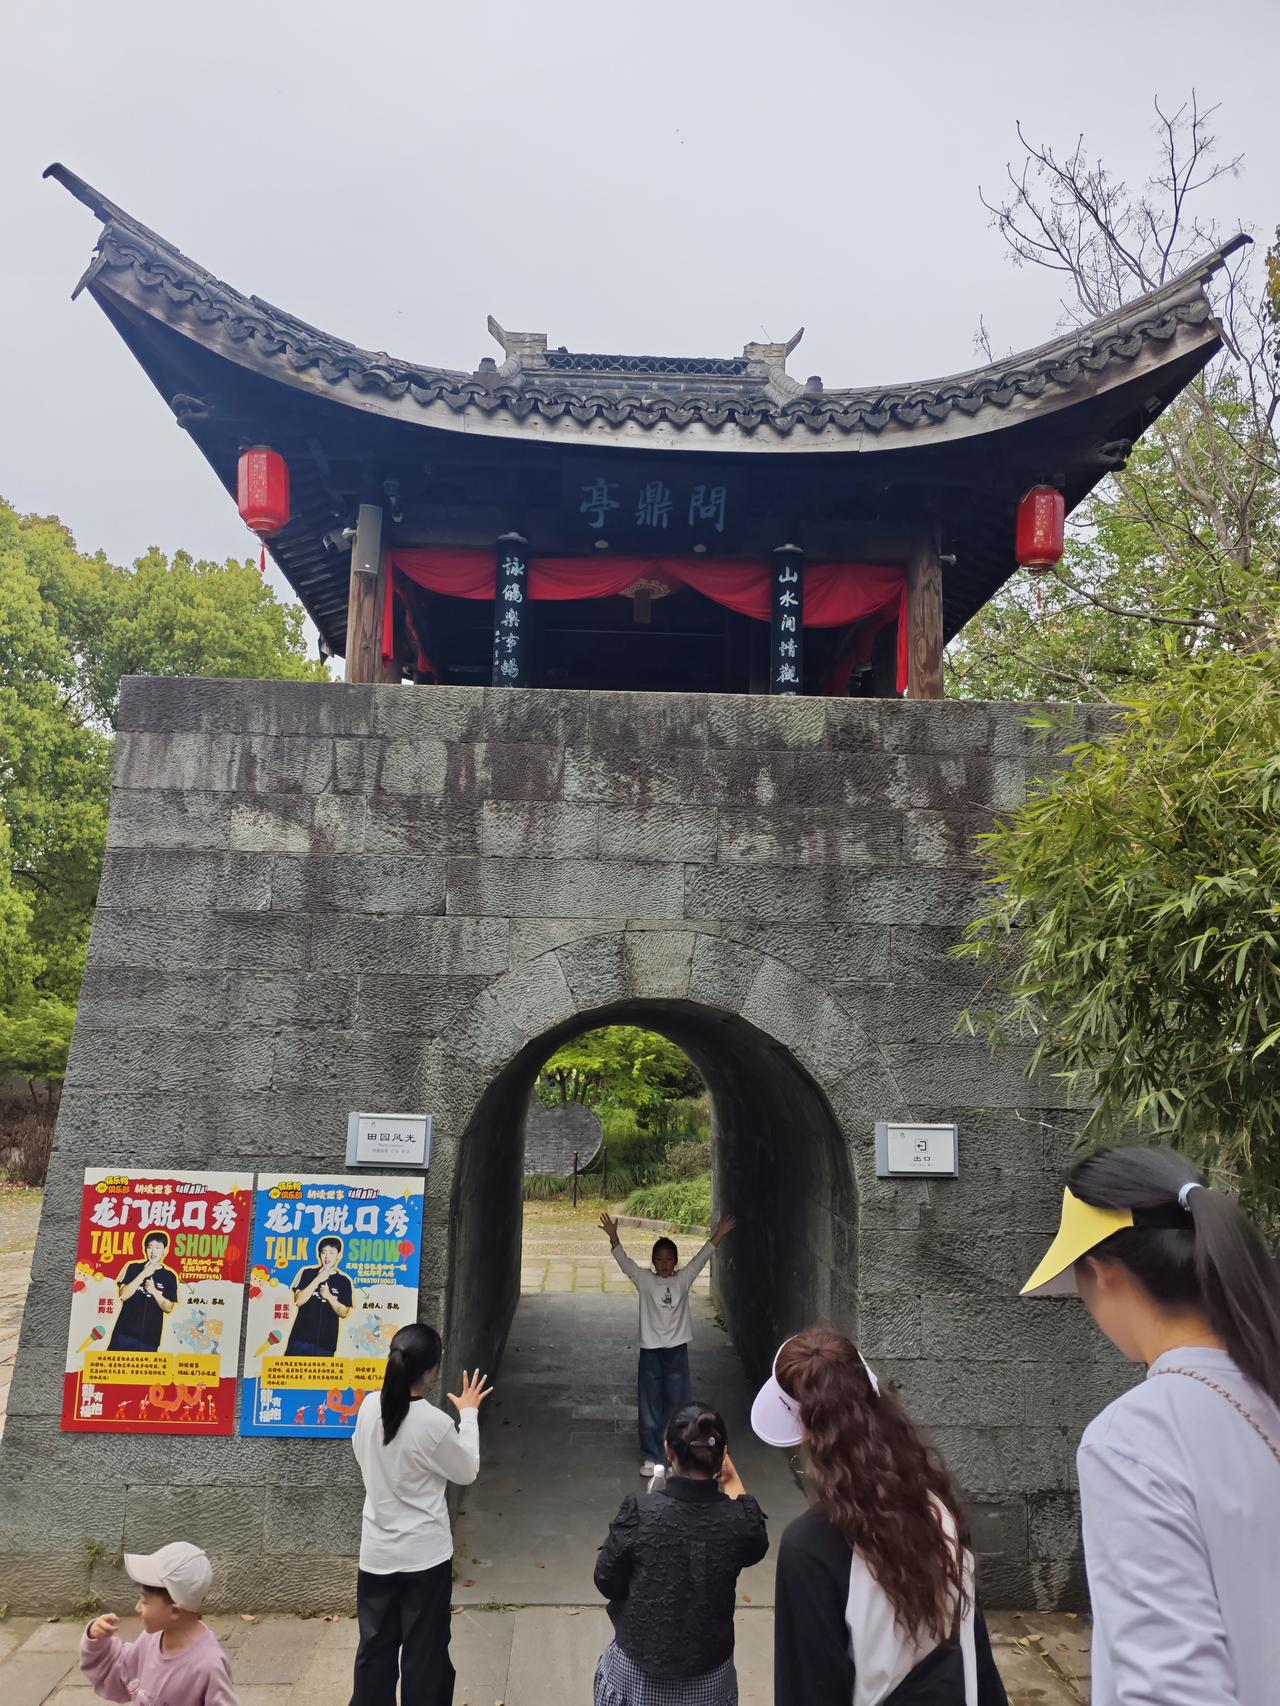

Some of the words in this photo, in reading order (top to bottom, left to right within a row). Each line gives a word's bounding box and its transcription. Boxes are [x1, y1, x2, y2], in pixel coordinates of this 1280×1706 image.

[367, 1132, 417, 1143] 田园风光
[89, 1196, 238, 1233] 龙门脱口秀
[264, 1201, 410, 1238] 龙门脱口秀
[90, 1231, 136, 1255] TALK
[174, 1233, 229, 1258] SHOW
[265, 1236, 310, 1261] TALK
[349, 1238, 402, 1263] SHOW
